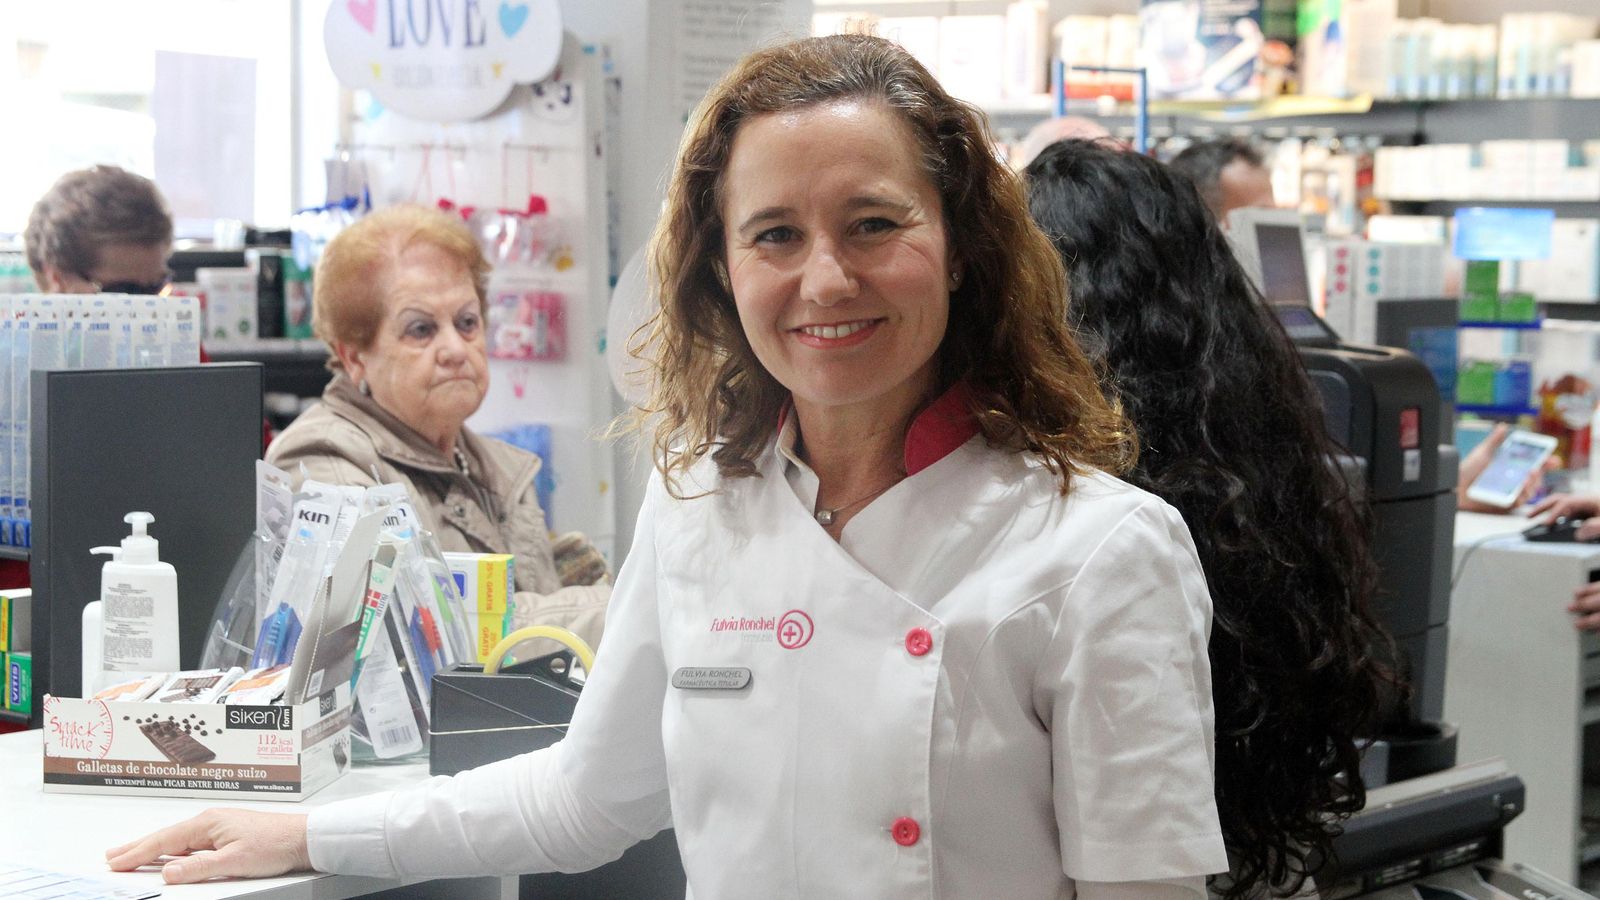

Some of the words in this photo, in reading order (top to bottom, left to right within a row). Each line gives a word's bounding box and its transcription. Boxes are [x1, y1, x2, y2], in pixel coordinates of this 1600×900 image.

[711, 616, 738, 632] Fulvia
[739, 616, 775, 631] Ronchel
[680, 670, 706, 678] FULVIA
[709, 670, 743, 679] RONCHEL
[11, 664, 19, 703] VITIS
[282, 709, 290, 727] form
[258, 735, 277, 744] 112
[77, 760, 122, 774] Galletas
[126, 762, 139, 774] de
[143, 763, 198, 776] chocolate
[201, 767, 234, 780] negro
[237, 767, 267, 778] suizo
[163, 779, 186, 788] PICAR
[187, 780, 213, 789] ENTRE
[214, 781, 240, 790] HORAS
